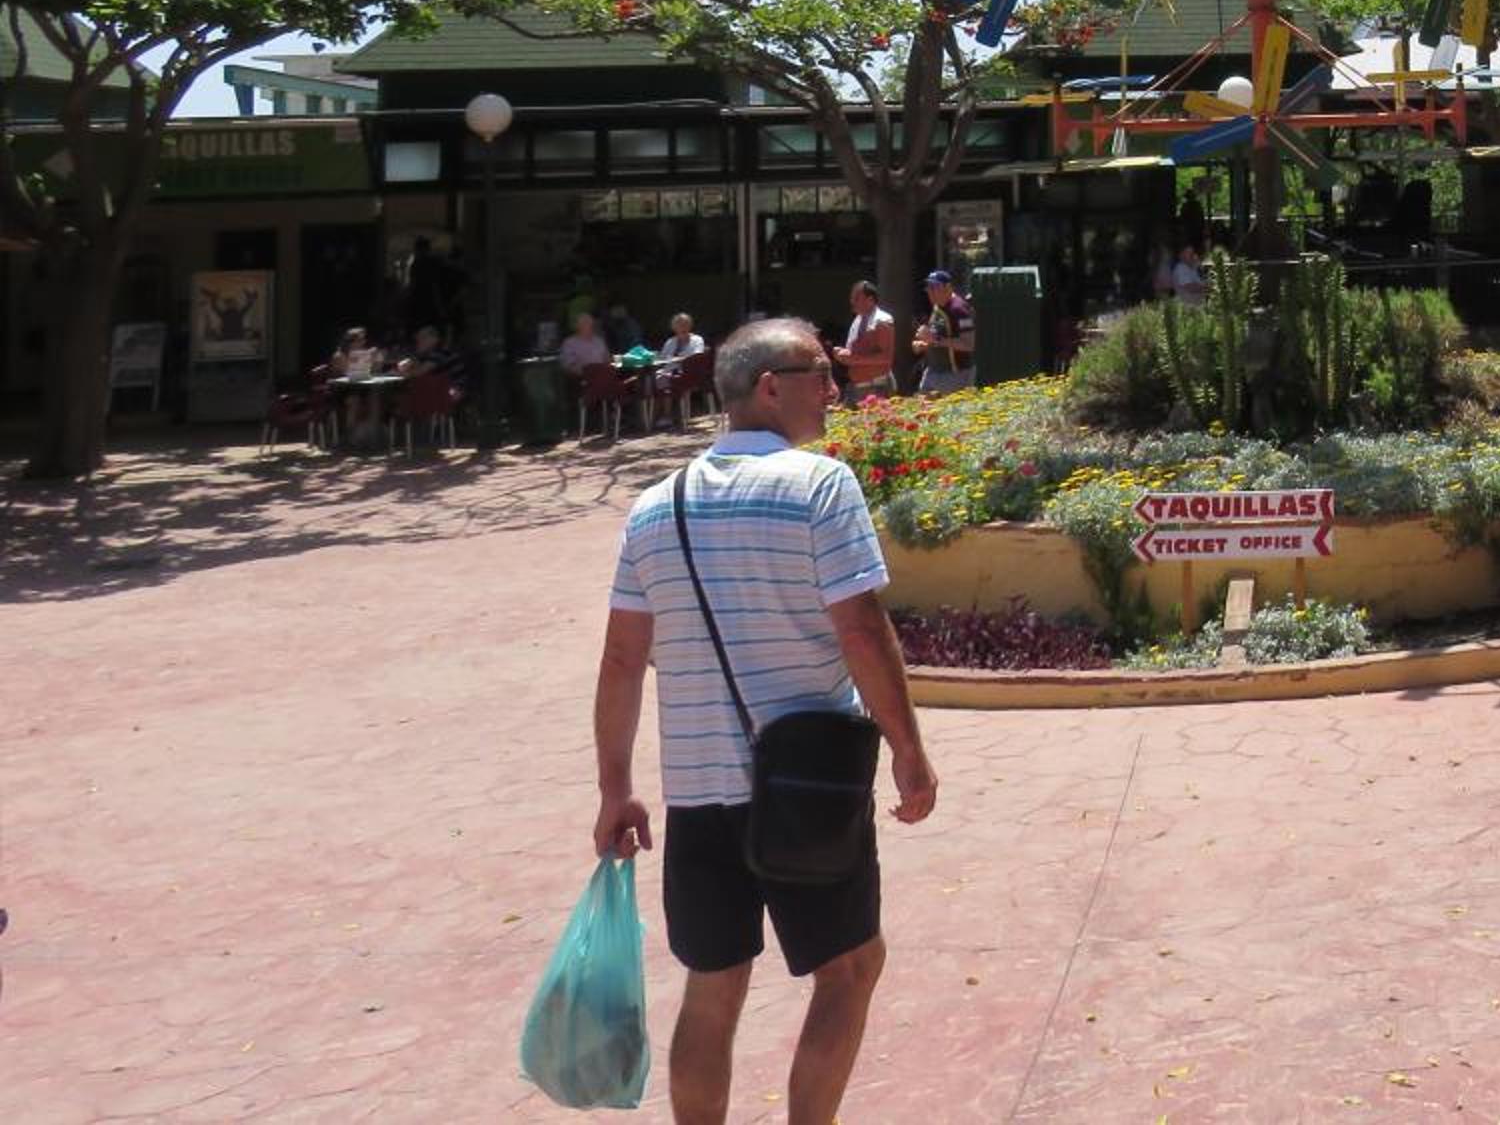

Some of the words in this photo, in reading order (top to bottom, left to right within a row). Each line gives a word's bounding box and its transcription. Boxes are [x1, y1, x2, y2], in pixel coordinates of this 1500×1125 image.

[164, 130, 297, 159] QUILLAS
[1150, 494, 1317, 521] TAQUILLAS
[1152, 537, 1229, 555] TICKET
[1239, 535, 1303, 551] OFFICE
